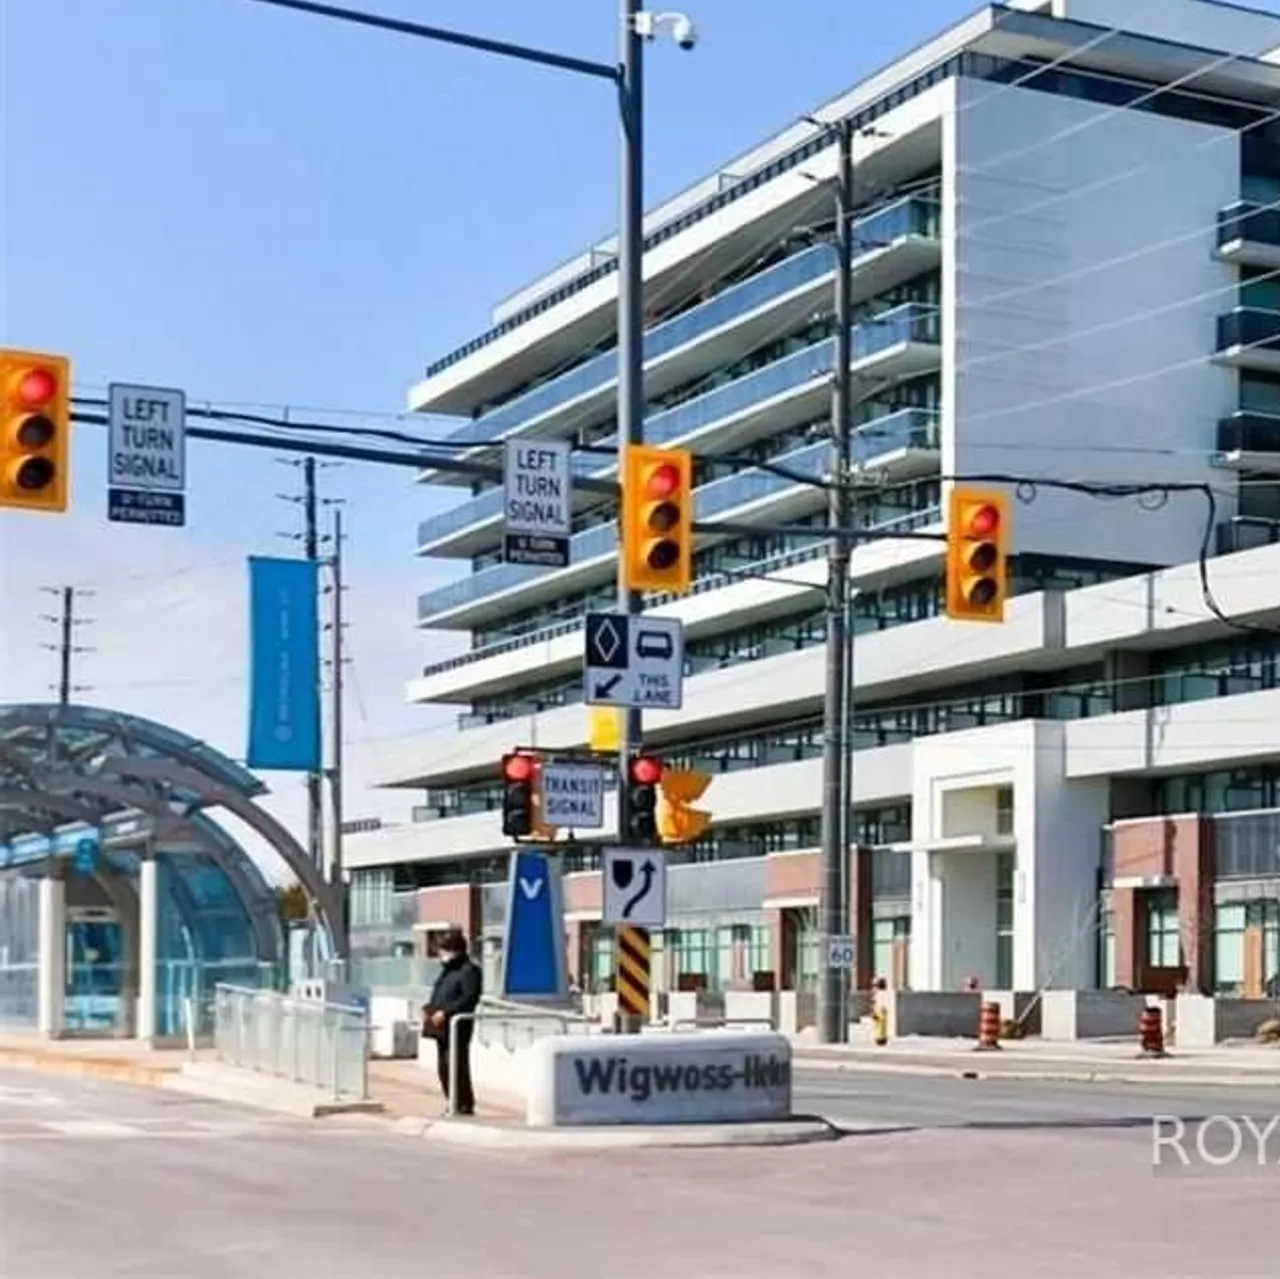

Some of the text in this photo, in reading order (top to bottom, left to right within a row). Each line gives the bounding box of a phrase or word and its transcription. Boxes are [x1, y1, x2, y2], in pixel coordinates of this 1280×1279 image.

[122, 397, 169, 421] LEFT
[121, 423, 175, 450] TURN
[113, 451, 180, 480] SIGNAL
[516, 449, 556, 471] LEFT
[516, 474, 560, 497] TURN
[508, 499, 565, 525] SIGNAL
[638, 673, 670, 688] THIS
[631, 689, 672, 704] LANE
[545, 775, 600, 794] TRANSIT
[547, 798, 597, 817] SIGNAL
[831, 948, 853, 963] 60
